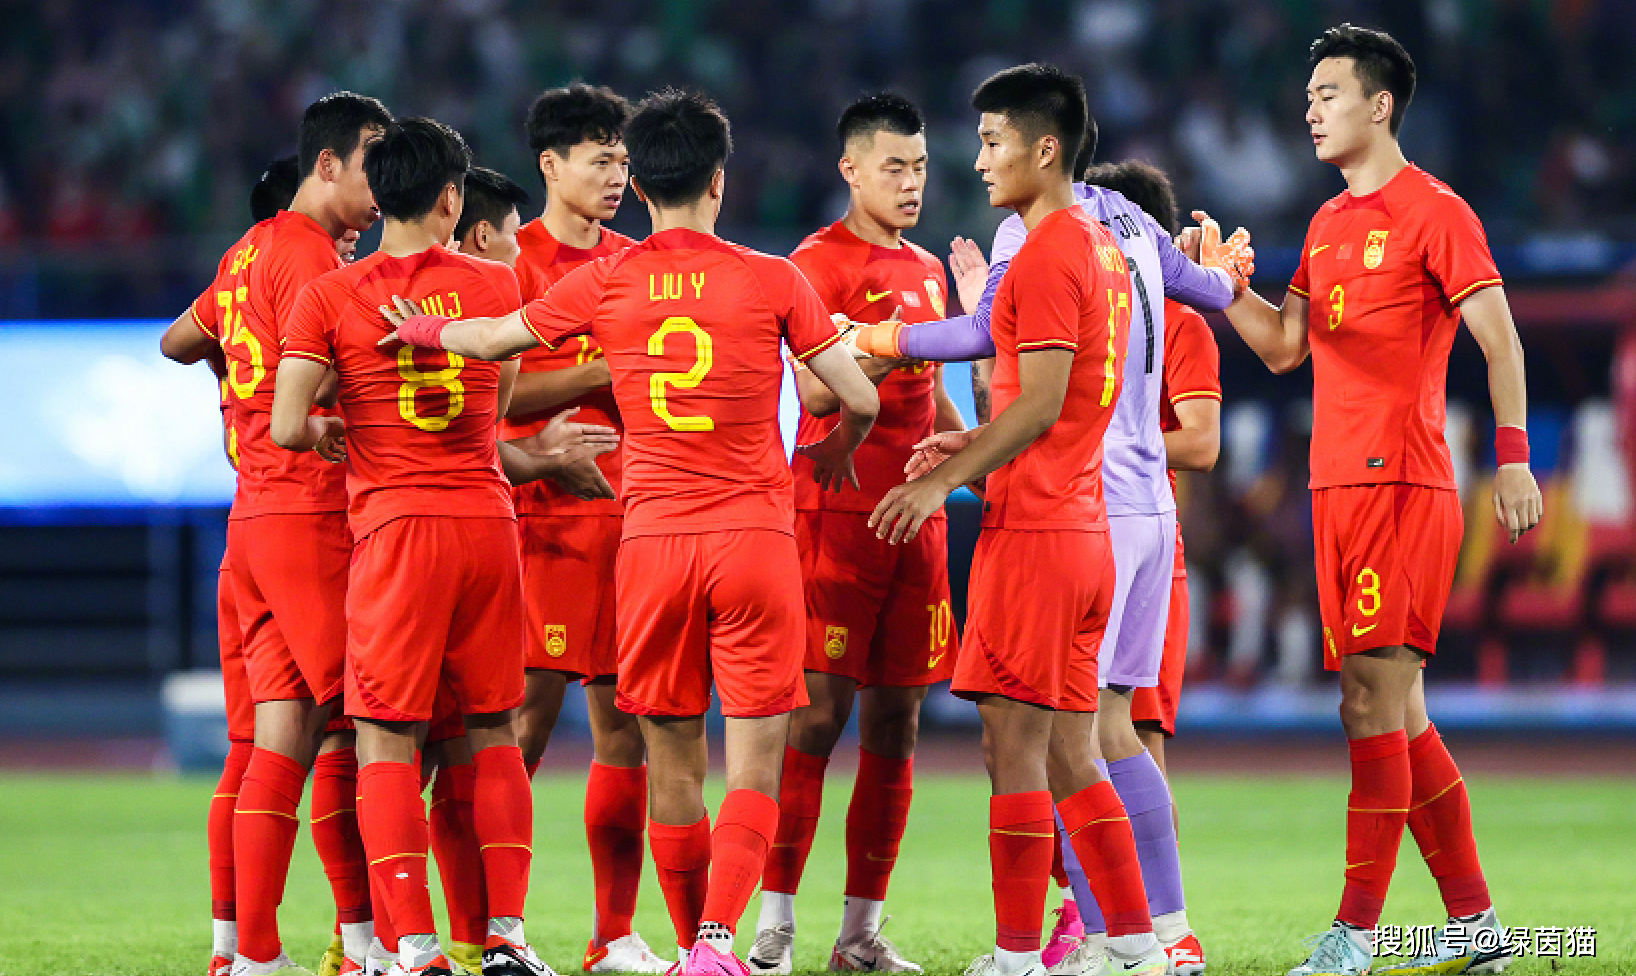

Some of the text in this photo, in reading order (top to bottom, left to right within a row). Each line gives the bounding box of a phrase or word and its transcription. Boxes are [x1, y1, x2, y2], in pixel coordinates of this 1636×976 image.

[649, 270, 706, 301] LIU Y
[1328, 284, 1345, 331] 3
[397, 344, 465, 432] 8
[647, 316, 715, 432] 2
[1356, 567, 1382, 617] 3
[926, 598, 951, 652] 10
